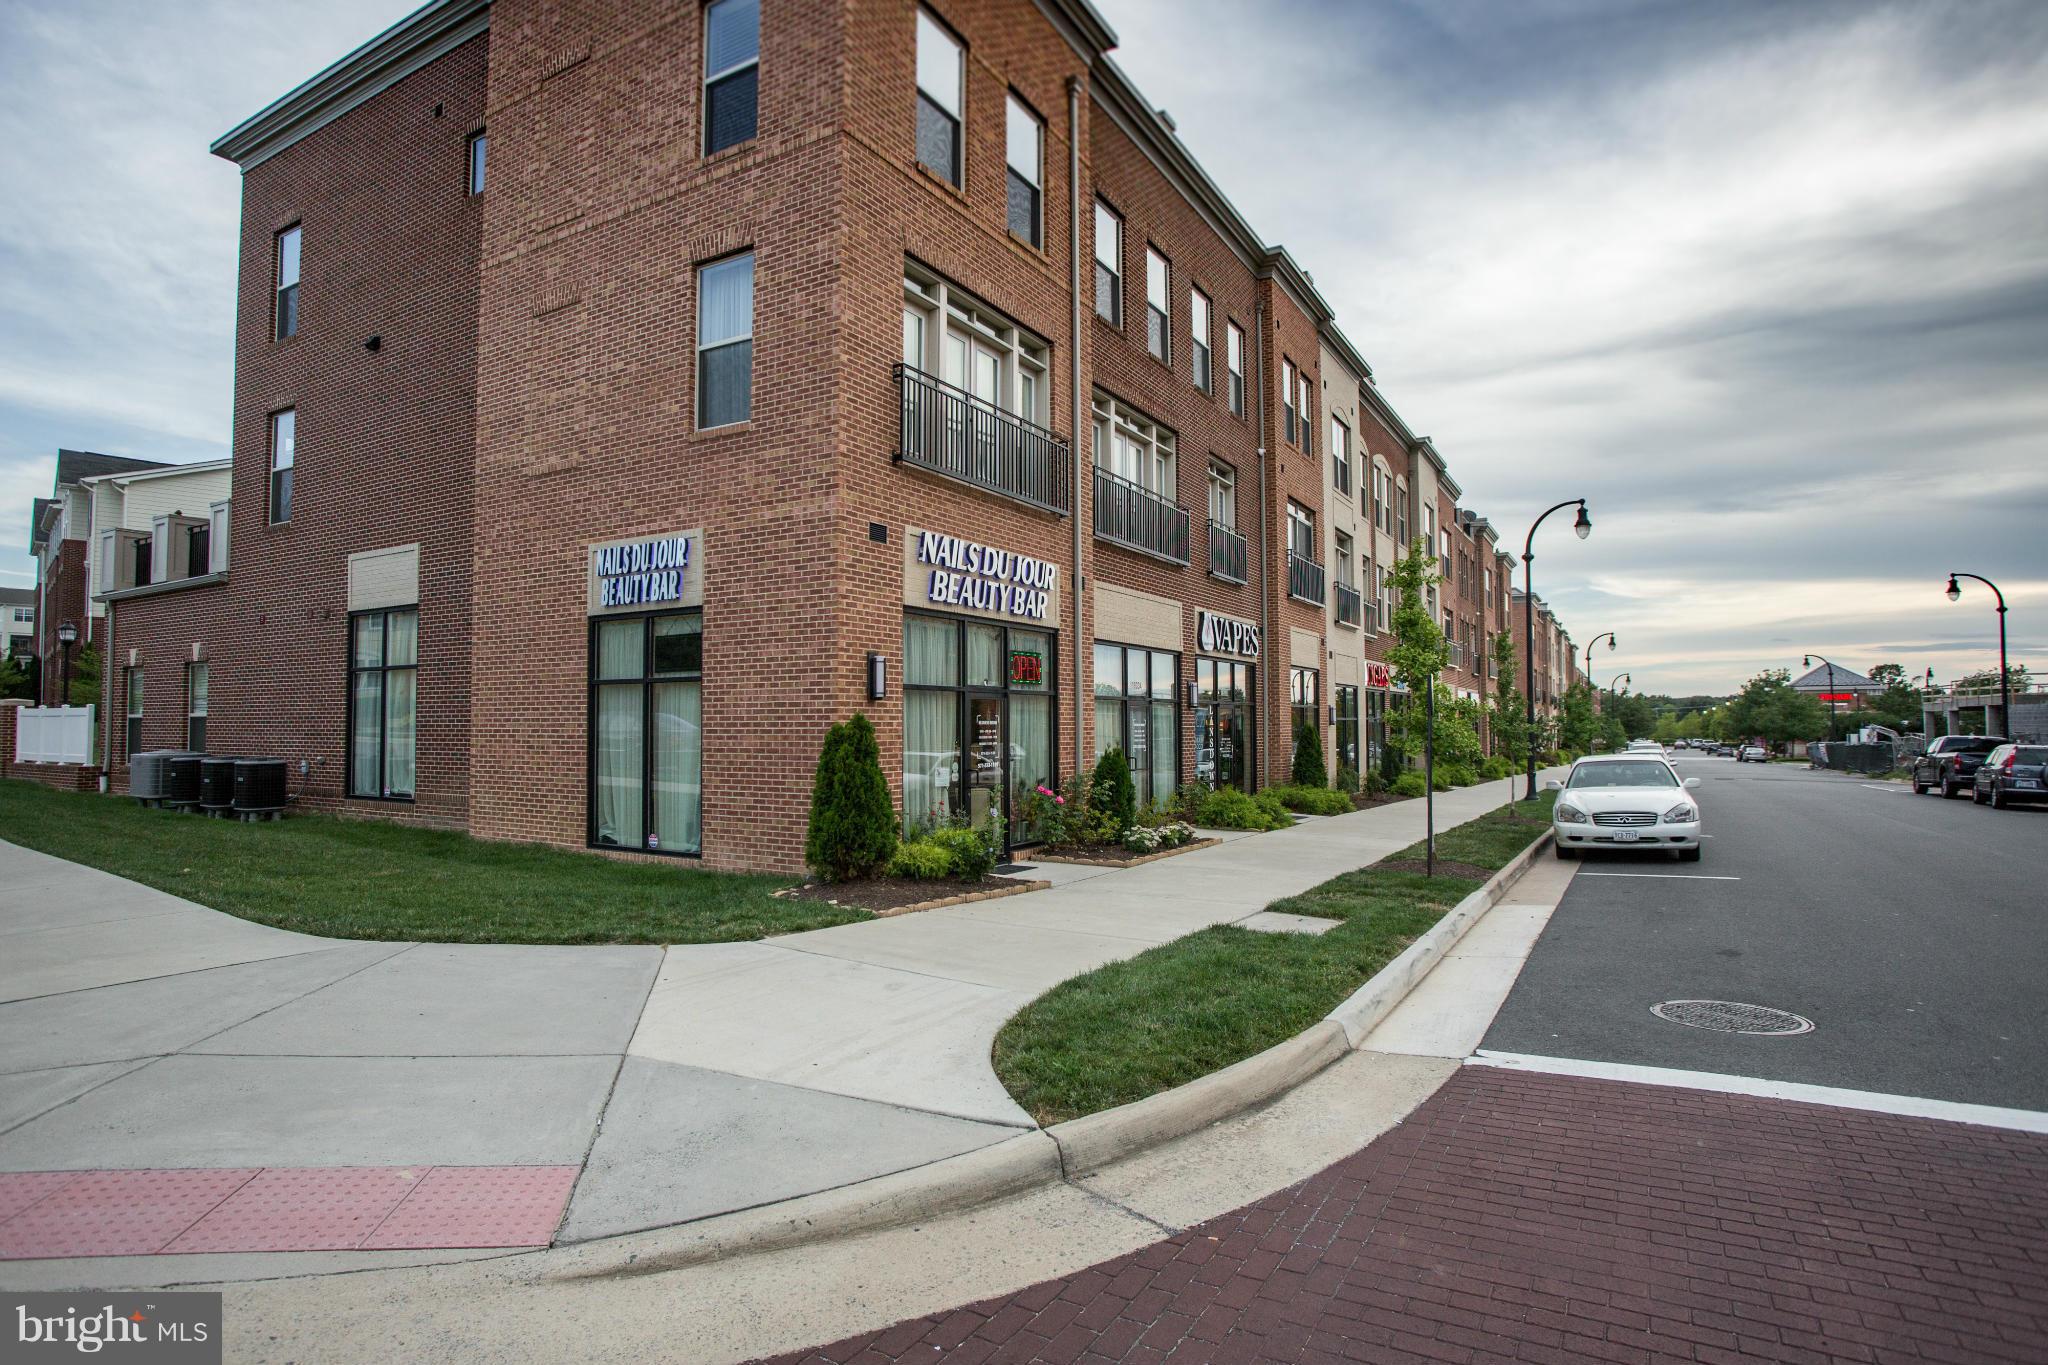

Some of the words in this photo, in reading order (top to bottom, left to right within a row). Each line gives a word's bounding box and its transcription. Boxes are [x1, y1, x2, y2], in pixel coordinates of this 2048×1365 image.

[596, 546, 630, 576] NAILS
[631, 542, 650, 572] DU
[651, 537, 687, 570] JOUR
[922, 531, 980, 573] NAILS
[983, 547, 1010, 579] DU
[1013, 555, 1056, 591] JOUR
[601, 574, 650, 606] BEAUTY
[650, 571, 679, 601] BAR
[932, 570, 1012, 613] BEAUTY
[1013, 587, 1049, 618] BAR
[1212, 616, 1259, 657] VAPES
[1013, 655, 1041, 681] OPEN
